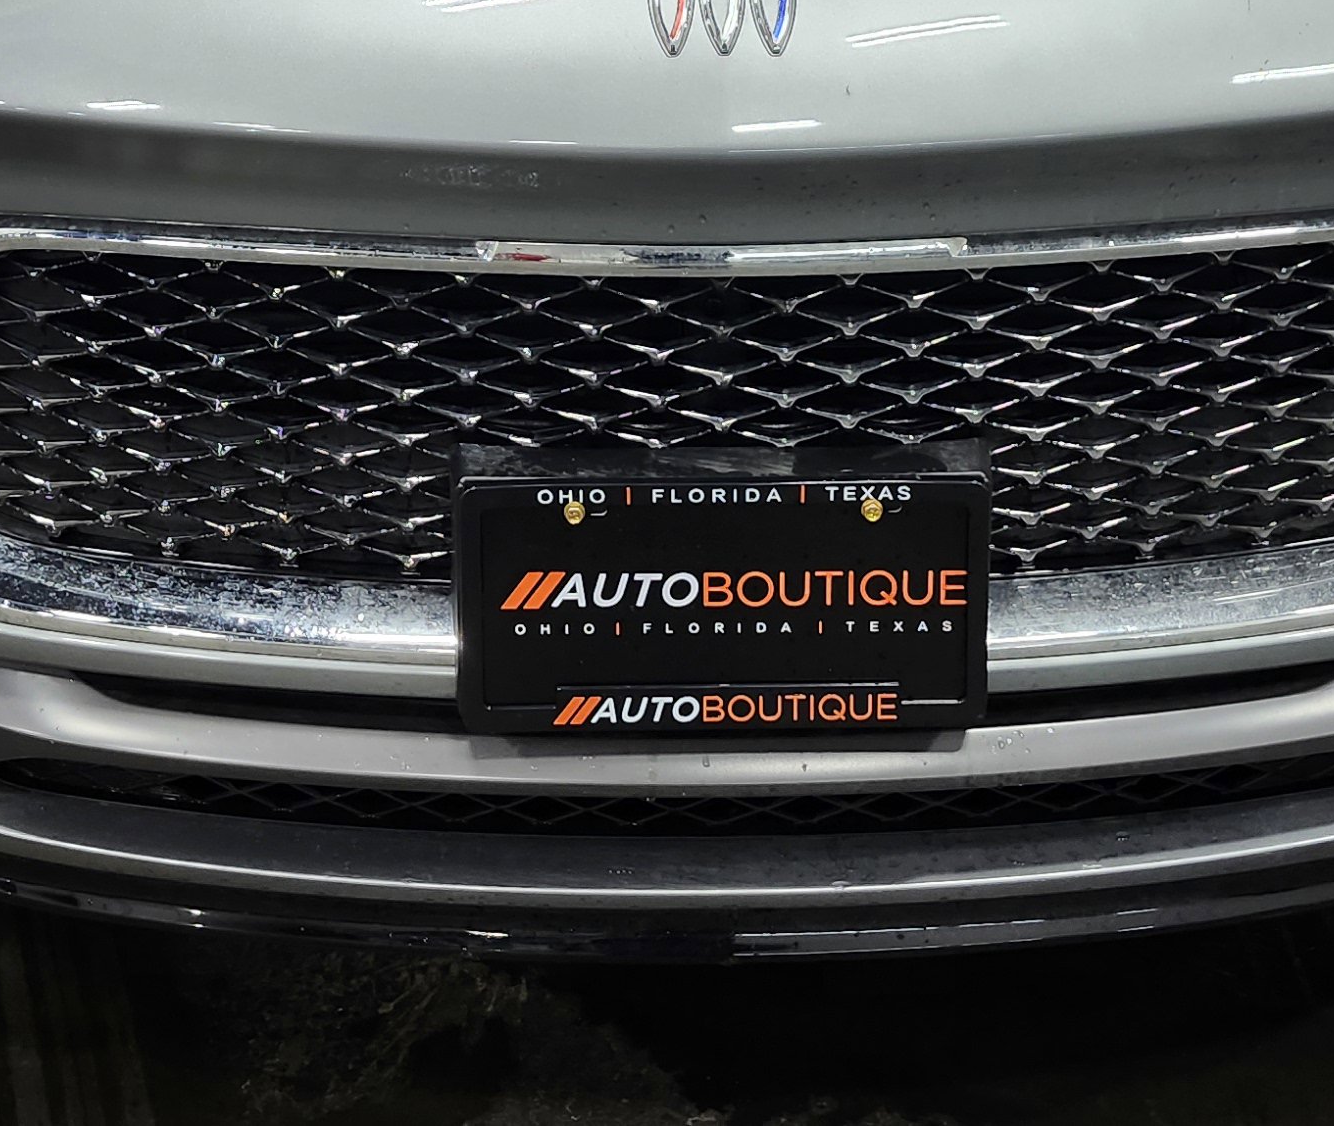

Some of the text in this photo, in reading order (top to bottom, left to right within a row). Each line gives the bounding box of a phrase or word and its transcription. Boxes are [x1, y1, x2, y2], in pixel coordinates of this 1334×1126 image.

[537, 485, 911, 505] OHIO FLORIDA TEXAS
[550, 569, 968, 608] AUTOBOUTIQUE
[514, 620, 953, 636] OHIO FLORIDA TEXAS
[590, 693, 898, 724] AUTOBOUTIQUE
